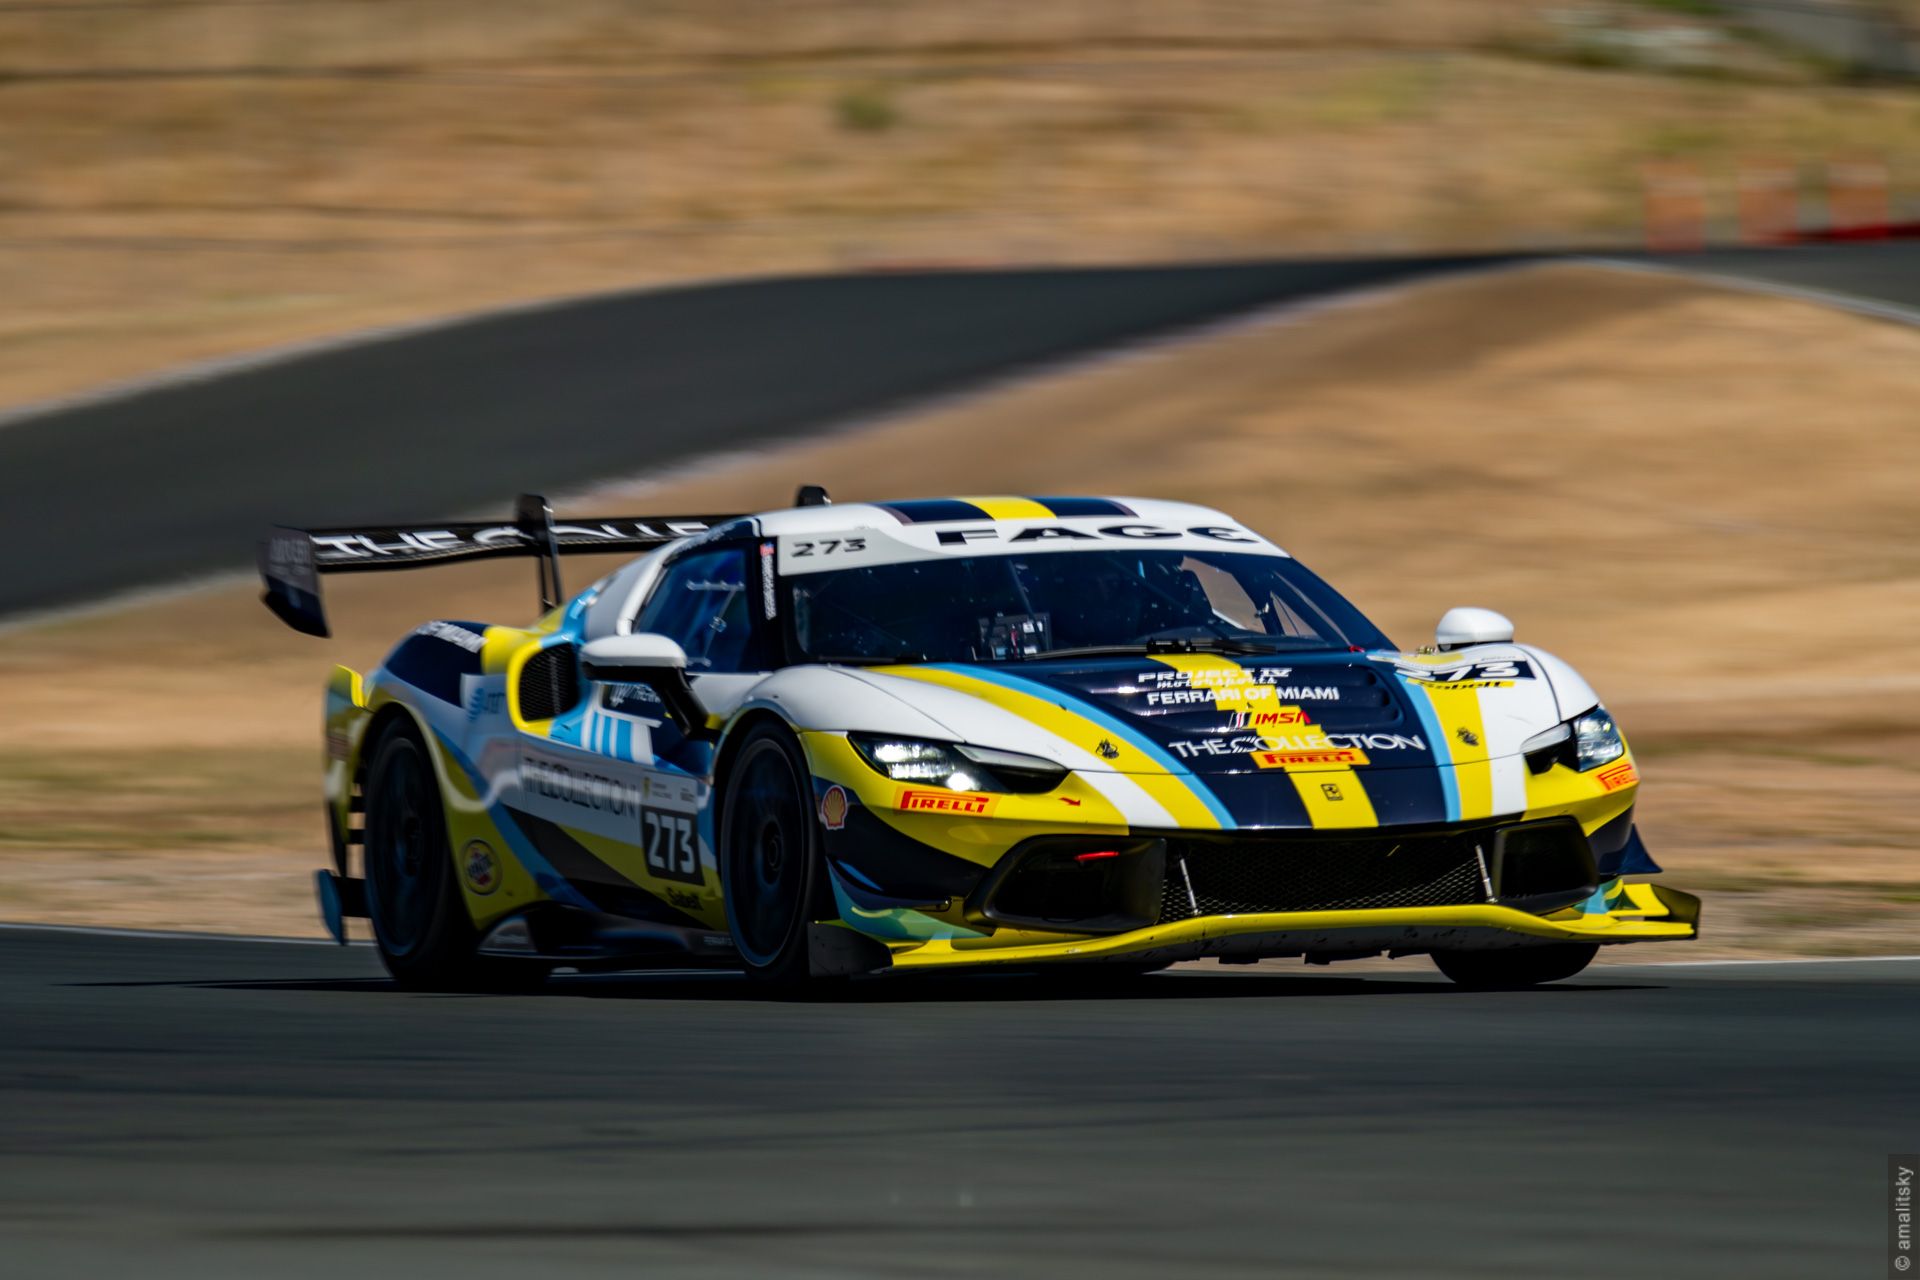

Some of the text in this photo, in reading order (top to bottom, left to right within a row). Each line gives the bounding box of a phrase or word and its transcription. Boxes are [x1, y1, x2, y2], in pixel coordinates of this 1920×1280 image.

[935, 525, 1261, 546] FAGE
[791, 538, 867, 558] 273
[1137, 667, 1293, 683] PROJECT IV
[1393, 660, 1520, 682] 273
[1146, 686, 1340, 706] FERRARI OF MIAMI
[1254, 710, 1312, 725] IMSA
[1264, 751, 1357, 765] PIRELLI
[901, 790, 989, 813] PIRELLI
[644, 810, 696, 875] 273
